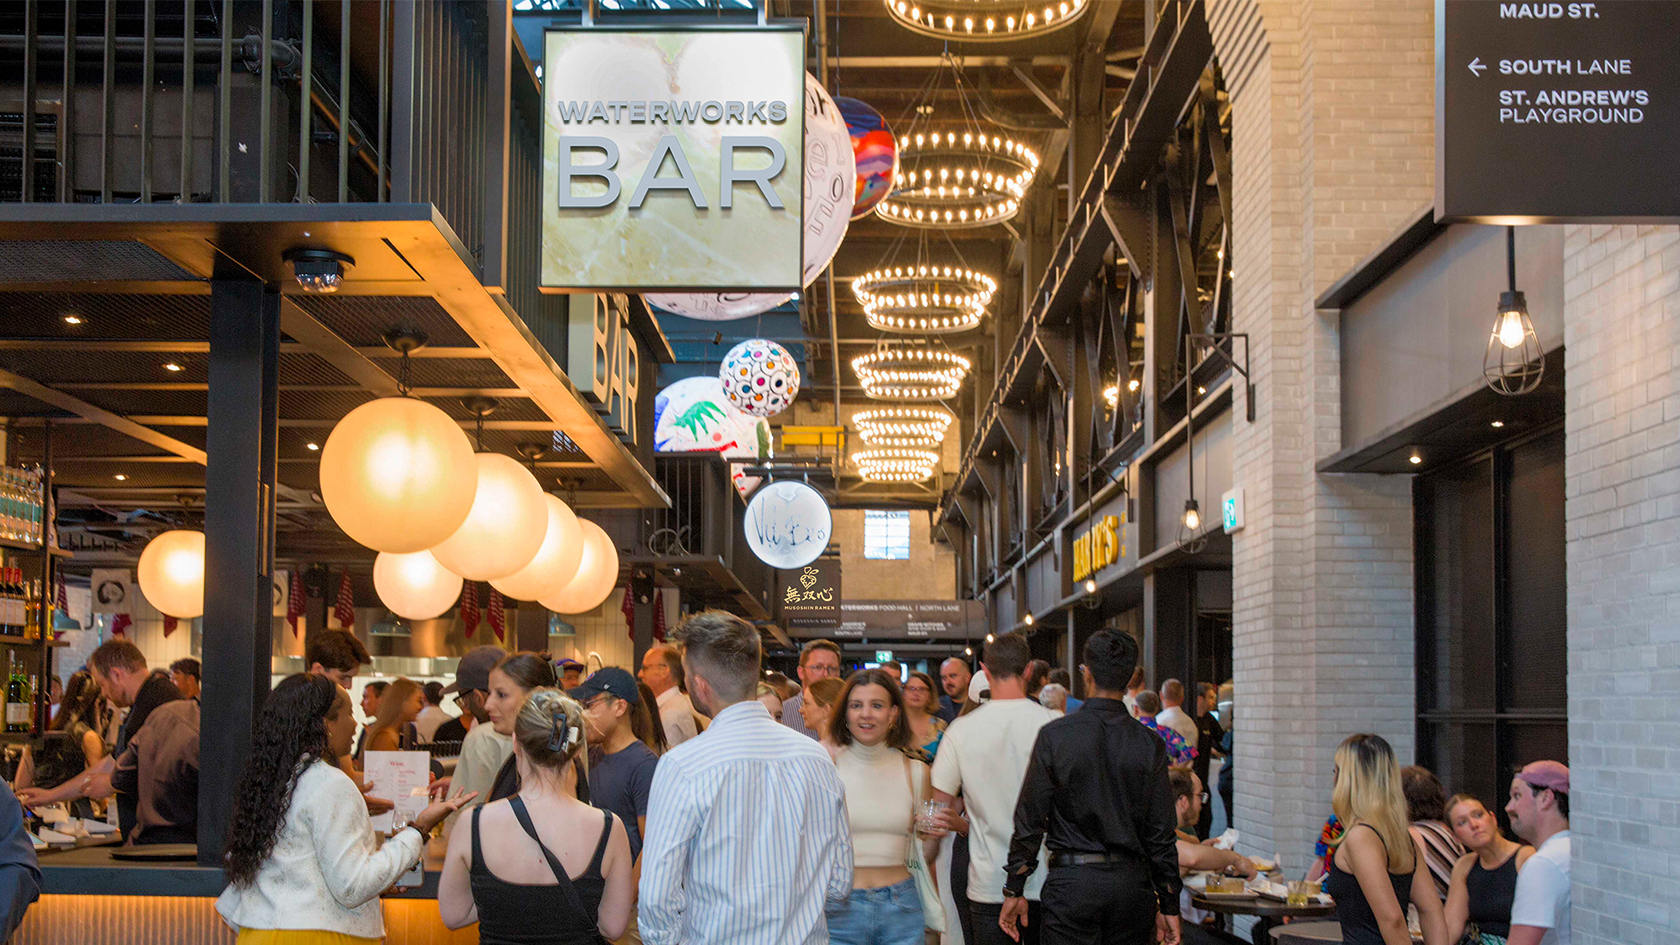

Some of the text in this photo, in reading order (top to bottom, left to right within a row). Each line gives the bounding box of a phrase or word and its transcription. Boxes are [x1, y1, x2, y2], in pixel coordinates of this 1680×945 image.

[1500, 3, 1600, 19] MAUD ST.
[1499, 59, 1632, 75] SOUTH LANE
[1499, 90, 1650, 106] ST. ANDREW'S
[558, 100, 788, 124] WATERWORKS
[1500, 108, 1644, 124] PLAYGROUND
[558, 135, 787, 209] BAR
[592, 292, 639, 447] BAR
[784, 586, 834, 604] 無双心
[943, 604, 960, 612] LANE
